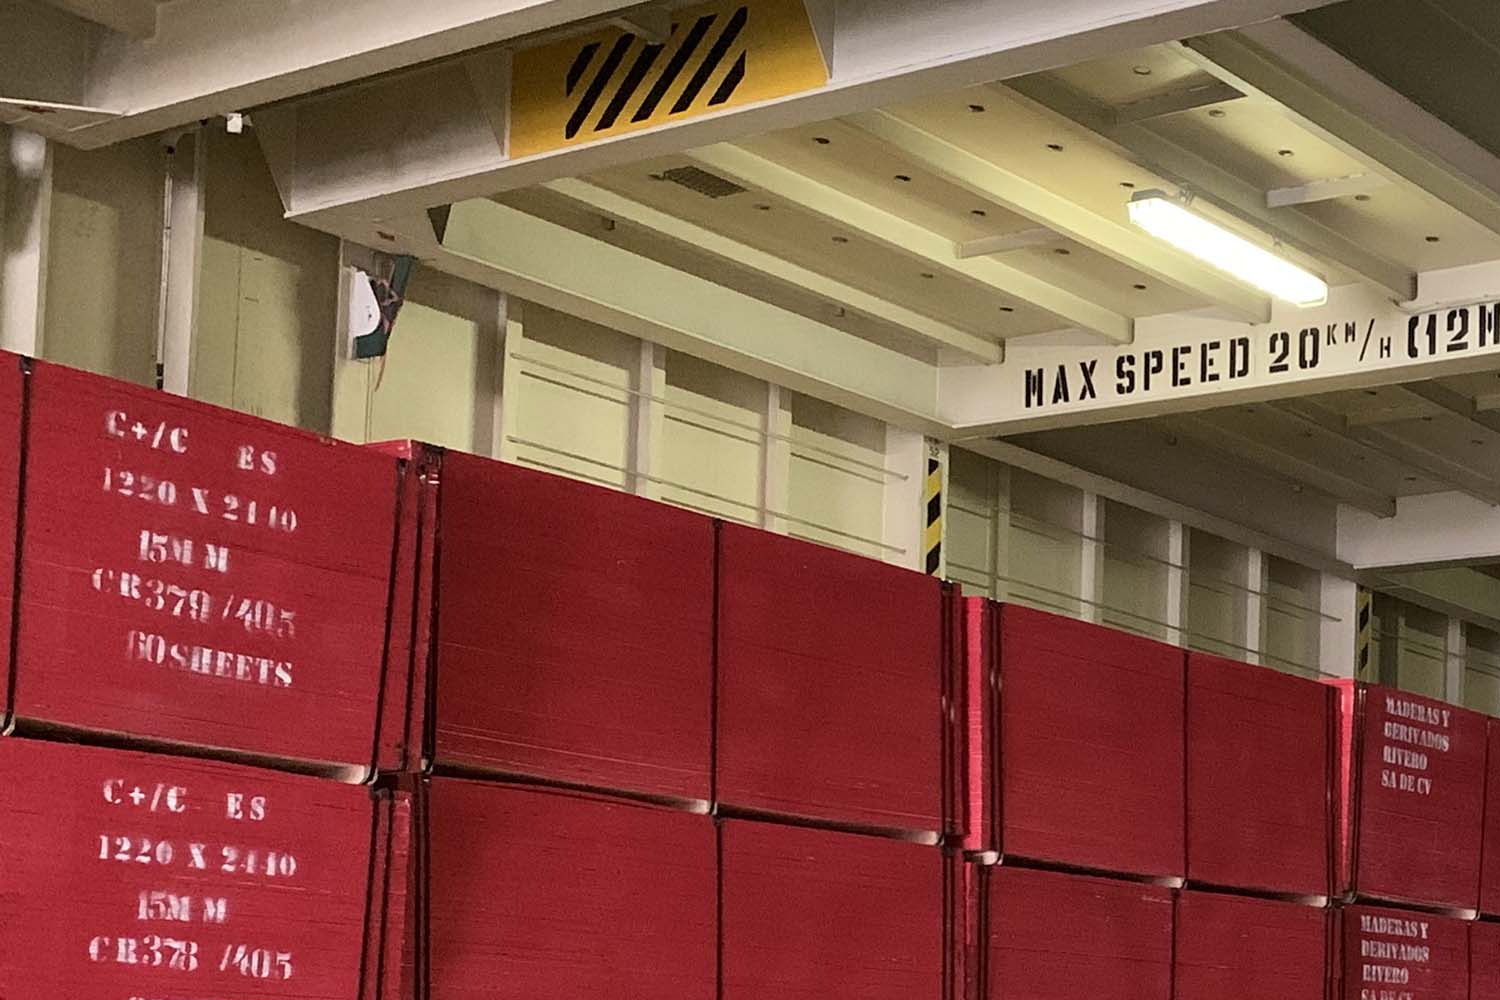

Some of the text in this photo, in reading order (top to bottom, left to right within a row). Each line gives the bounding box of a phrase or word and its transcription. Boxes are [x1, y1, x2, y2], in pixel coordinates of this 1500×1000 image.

[1026, 360, 1097, 407] MAX
[1117, 333, 1249, 396] SPEED
[1270, 328, 1319, 373] 20
[104, 468, 176, 504] 1220
[192, 488, 208, 513] X
[1385, 697, 1449, 727] MADERAS Y
[1383, 721, 1450, 753] DERIVADOS
[1383, 744, 1428, 771] RIVERO
[1382, 770, 1430, 794] SA DE CV
[100, 836, 172, 863] 1220
[189, 844, 205, 868] X
[1361, 916, 1428, 938] MADERAS Y
[1362, 940, 1429, 962] DERIVADOS
[1363, 965, 1408, 984] RIVERO
